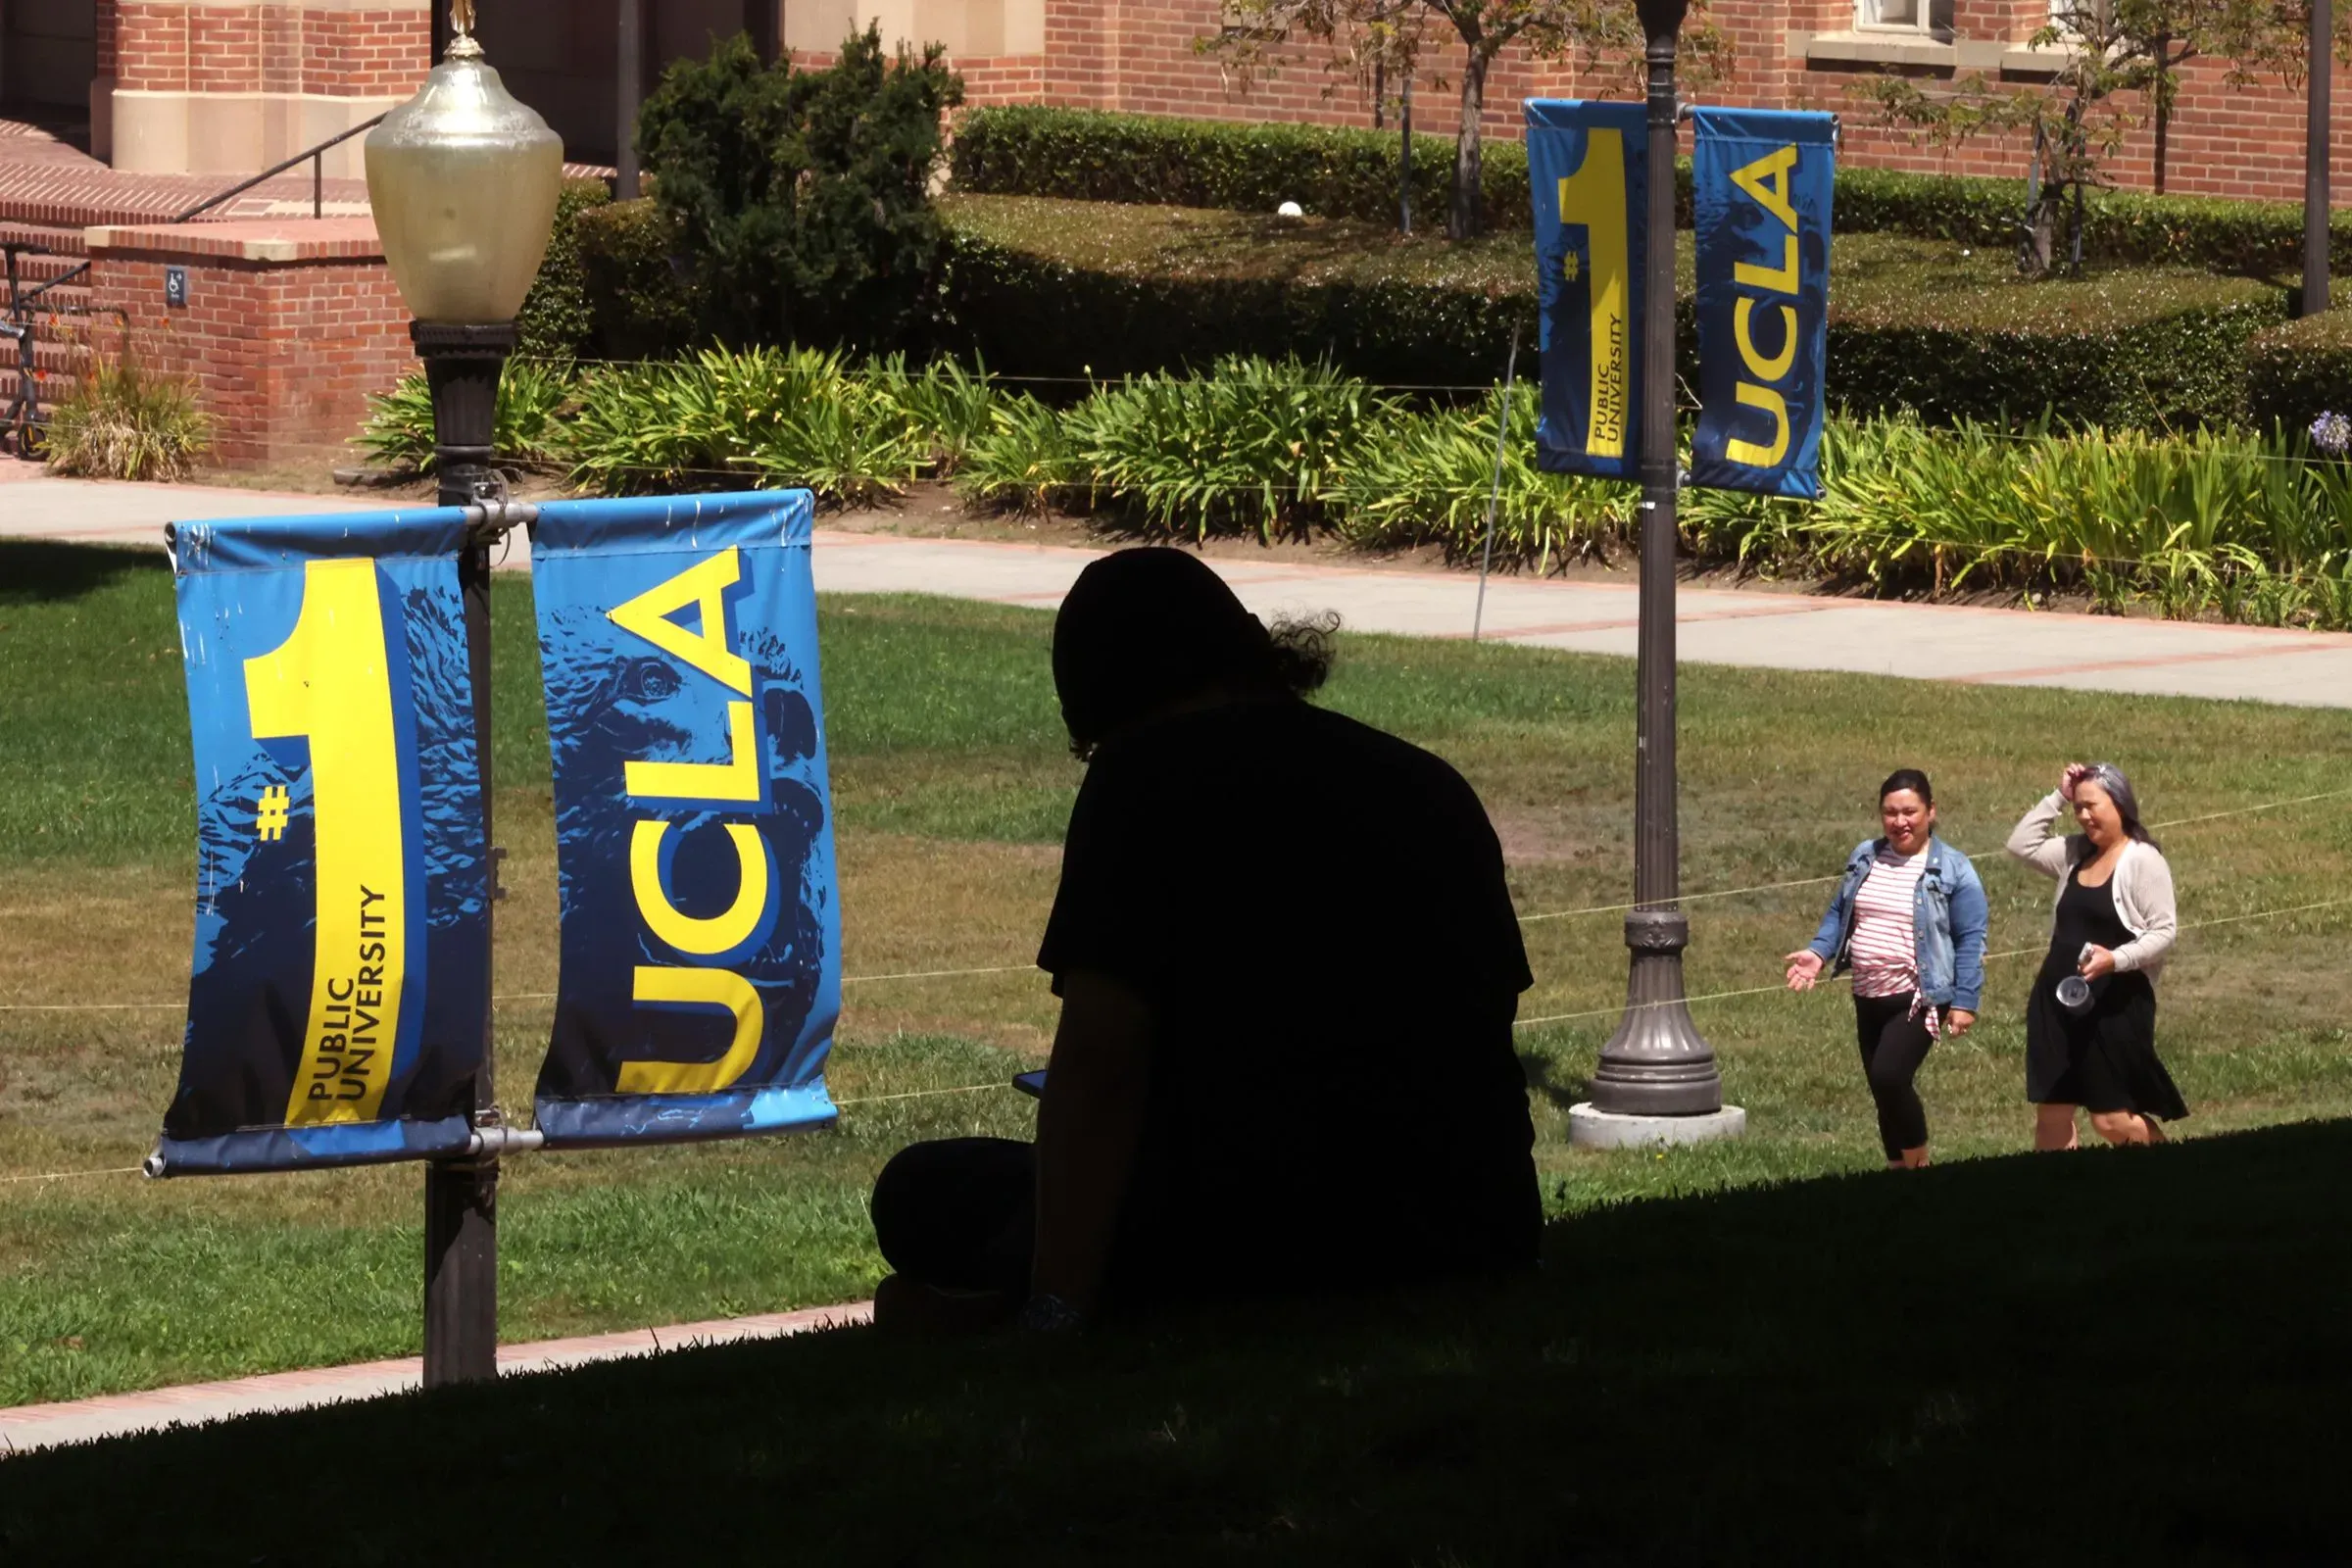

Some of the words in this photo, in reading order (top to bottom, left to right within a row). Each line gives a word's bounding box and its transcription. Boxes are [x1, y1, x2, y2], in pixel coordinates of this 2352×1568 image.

[1607, 314, 1623, 443] UNIVERSITY
[1726, 143, 1799, 468] UCLA
[1593, 364, 1610, 441] PUBLIC
[605, 545, 767, 1094] UCLA
[308, 978, 354, 1102] PUBLIC
[335, 885, 386, 1102] UNIVERSITY
